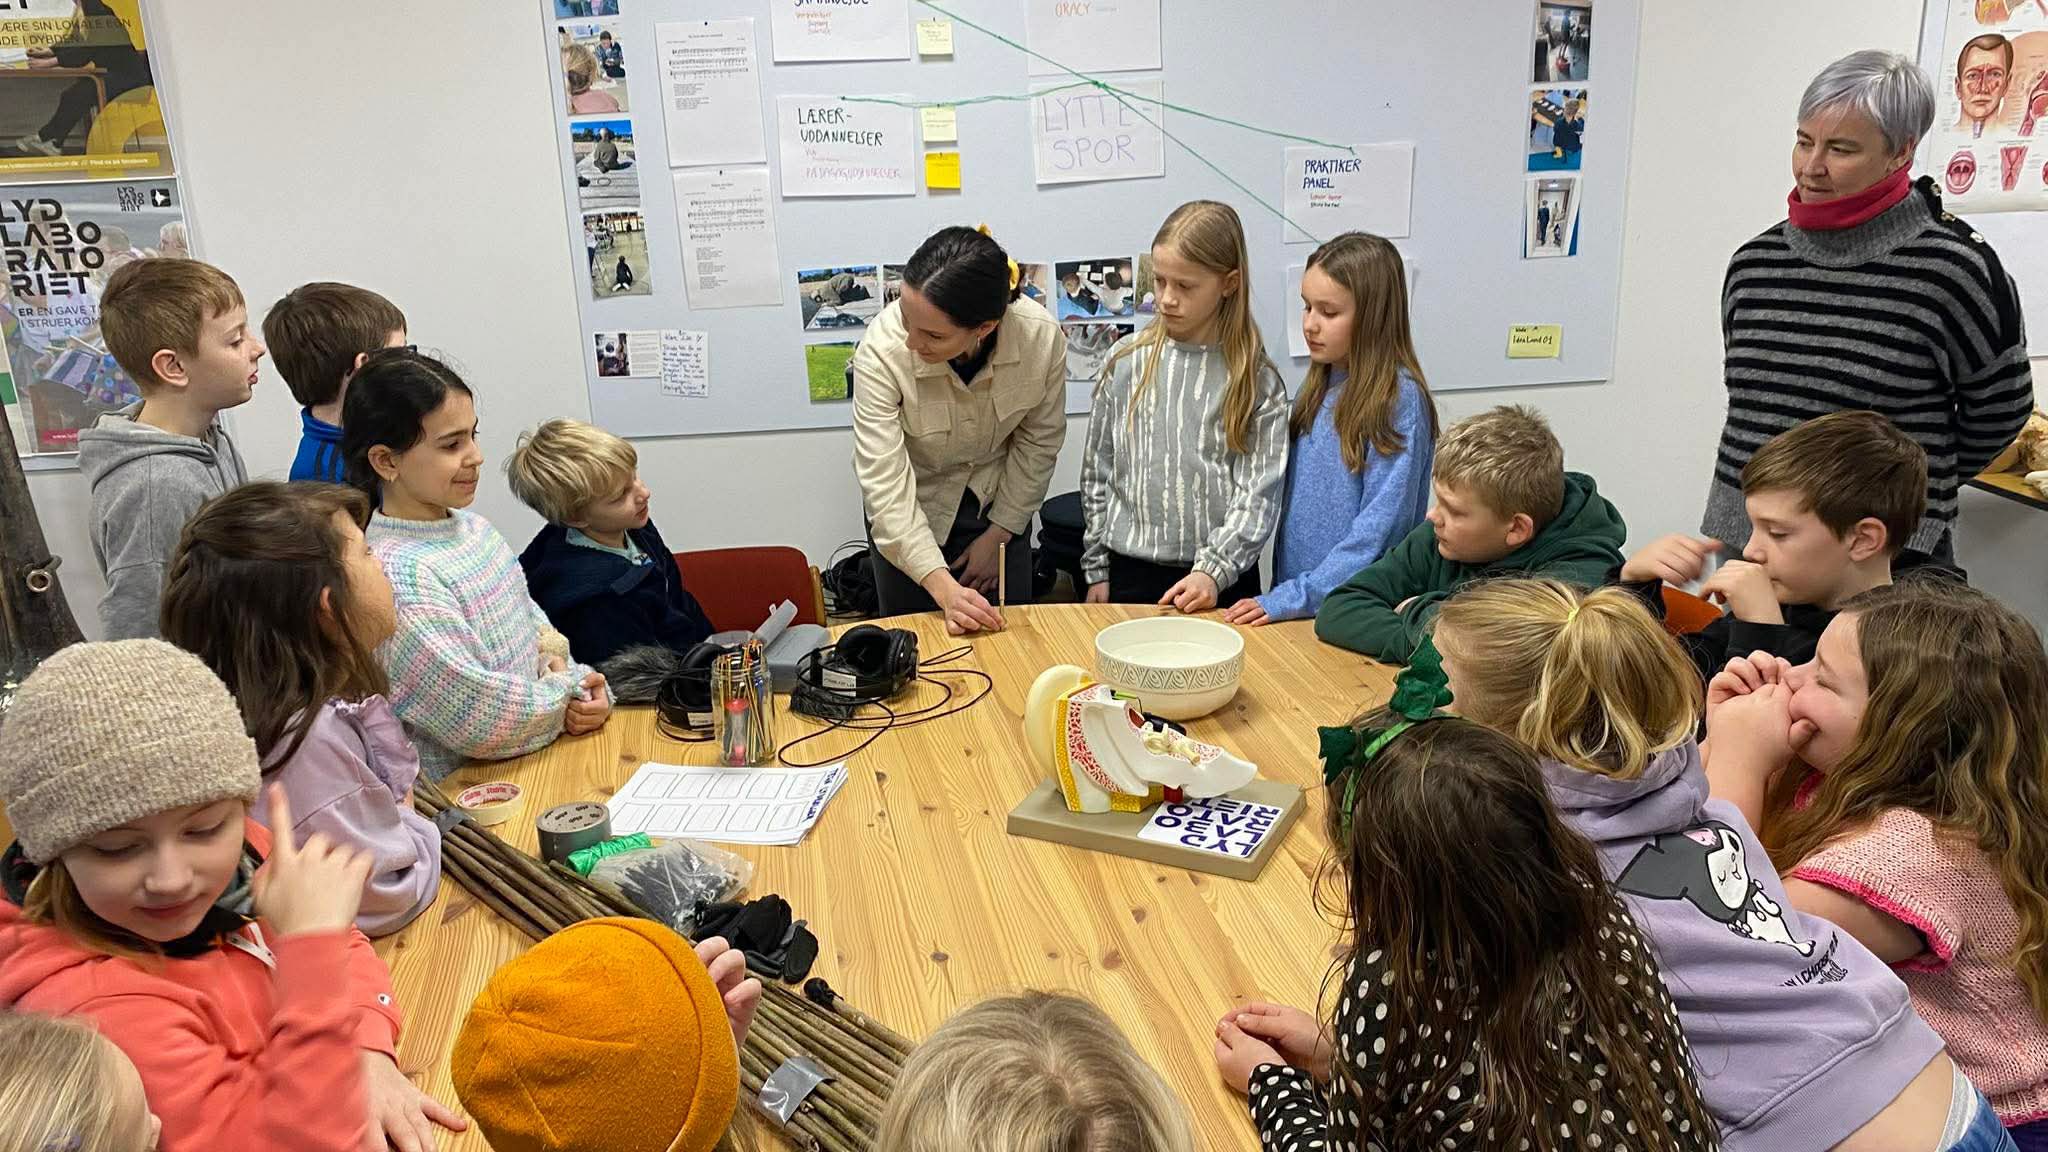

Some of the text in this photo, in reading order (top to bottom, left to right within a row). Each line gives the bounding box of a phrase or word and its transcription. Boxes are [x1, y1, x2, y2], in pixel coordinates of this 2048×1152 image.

[32, 21, 52, 31] SIN
[800, 128, 883, 147] UDDANNELSER
[1053, 134, 1135, 170] SPOR
[1304, 158, 1361, 175] PRAKTIKER
[1302, 177, 1335, 189] PANEL
[0, 198, 62, 223] LYD
[0, 221, 101, 247] LABO
[5, 246, 105, 272] RATO
[10, 271, 90, 297] RIET
[18, 308, 34, 317] ER
[38, 306, 53, 316] EN
[56, 304, 87, 315] GAVE
[27, 317, 74, 329] STRUER
[1154, 815, 1264, 844] LABO
[1179, 833, 1258, 857] LYD
